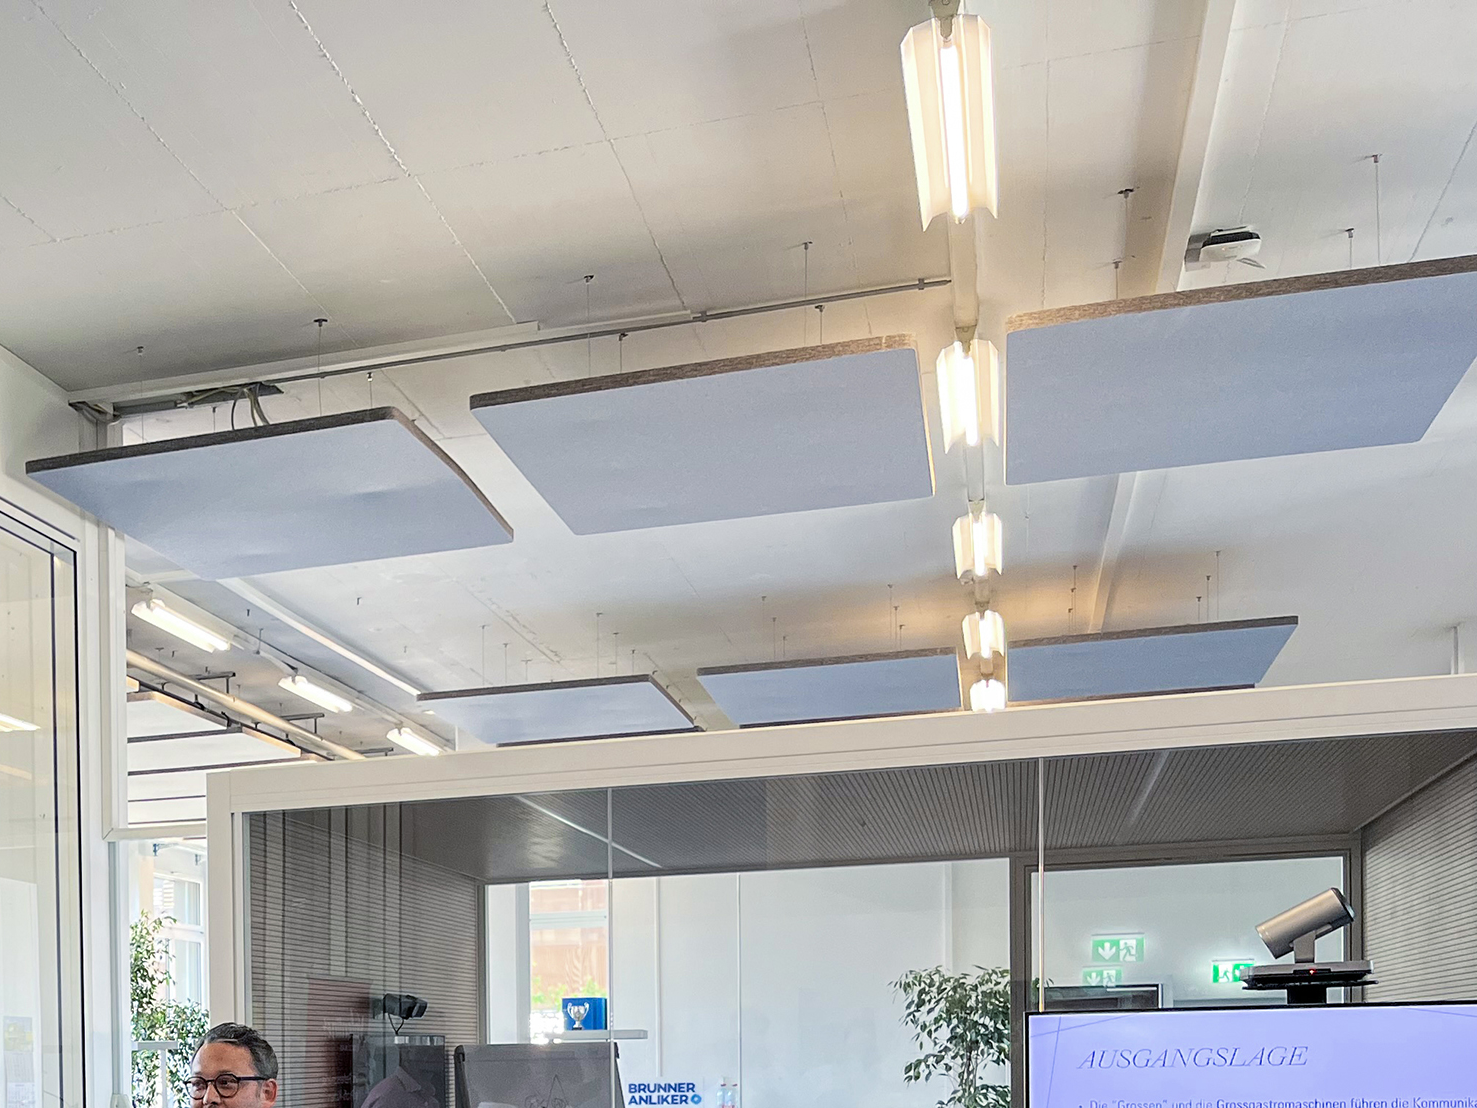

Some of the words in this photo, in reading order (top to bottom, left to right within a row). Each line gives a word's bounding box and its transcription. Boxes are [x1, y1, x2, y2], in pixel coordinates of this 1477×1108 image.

[1077, 1046, 1309, 1069] AUSGANGSLAGE
[628, 1082, 696, 1094] BRUNNER
[628, 1094, 689, 1106] ANLIKER
[1390, 1097, 1409, 1108] die
